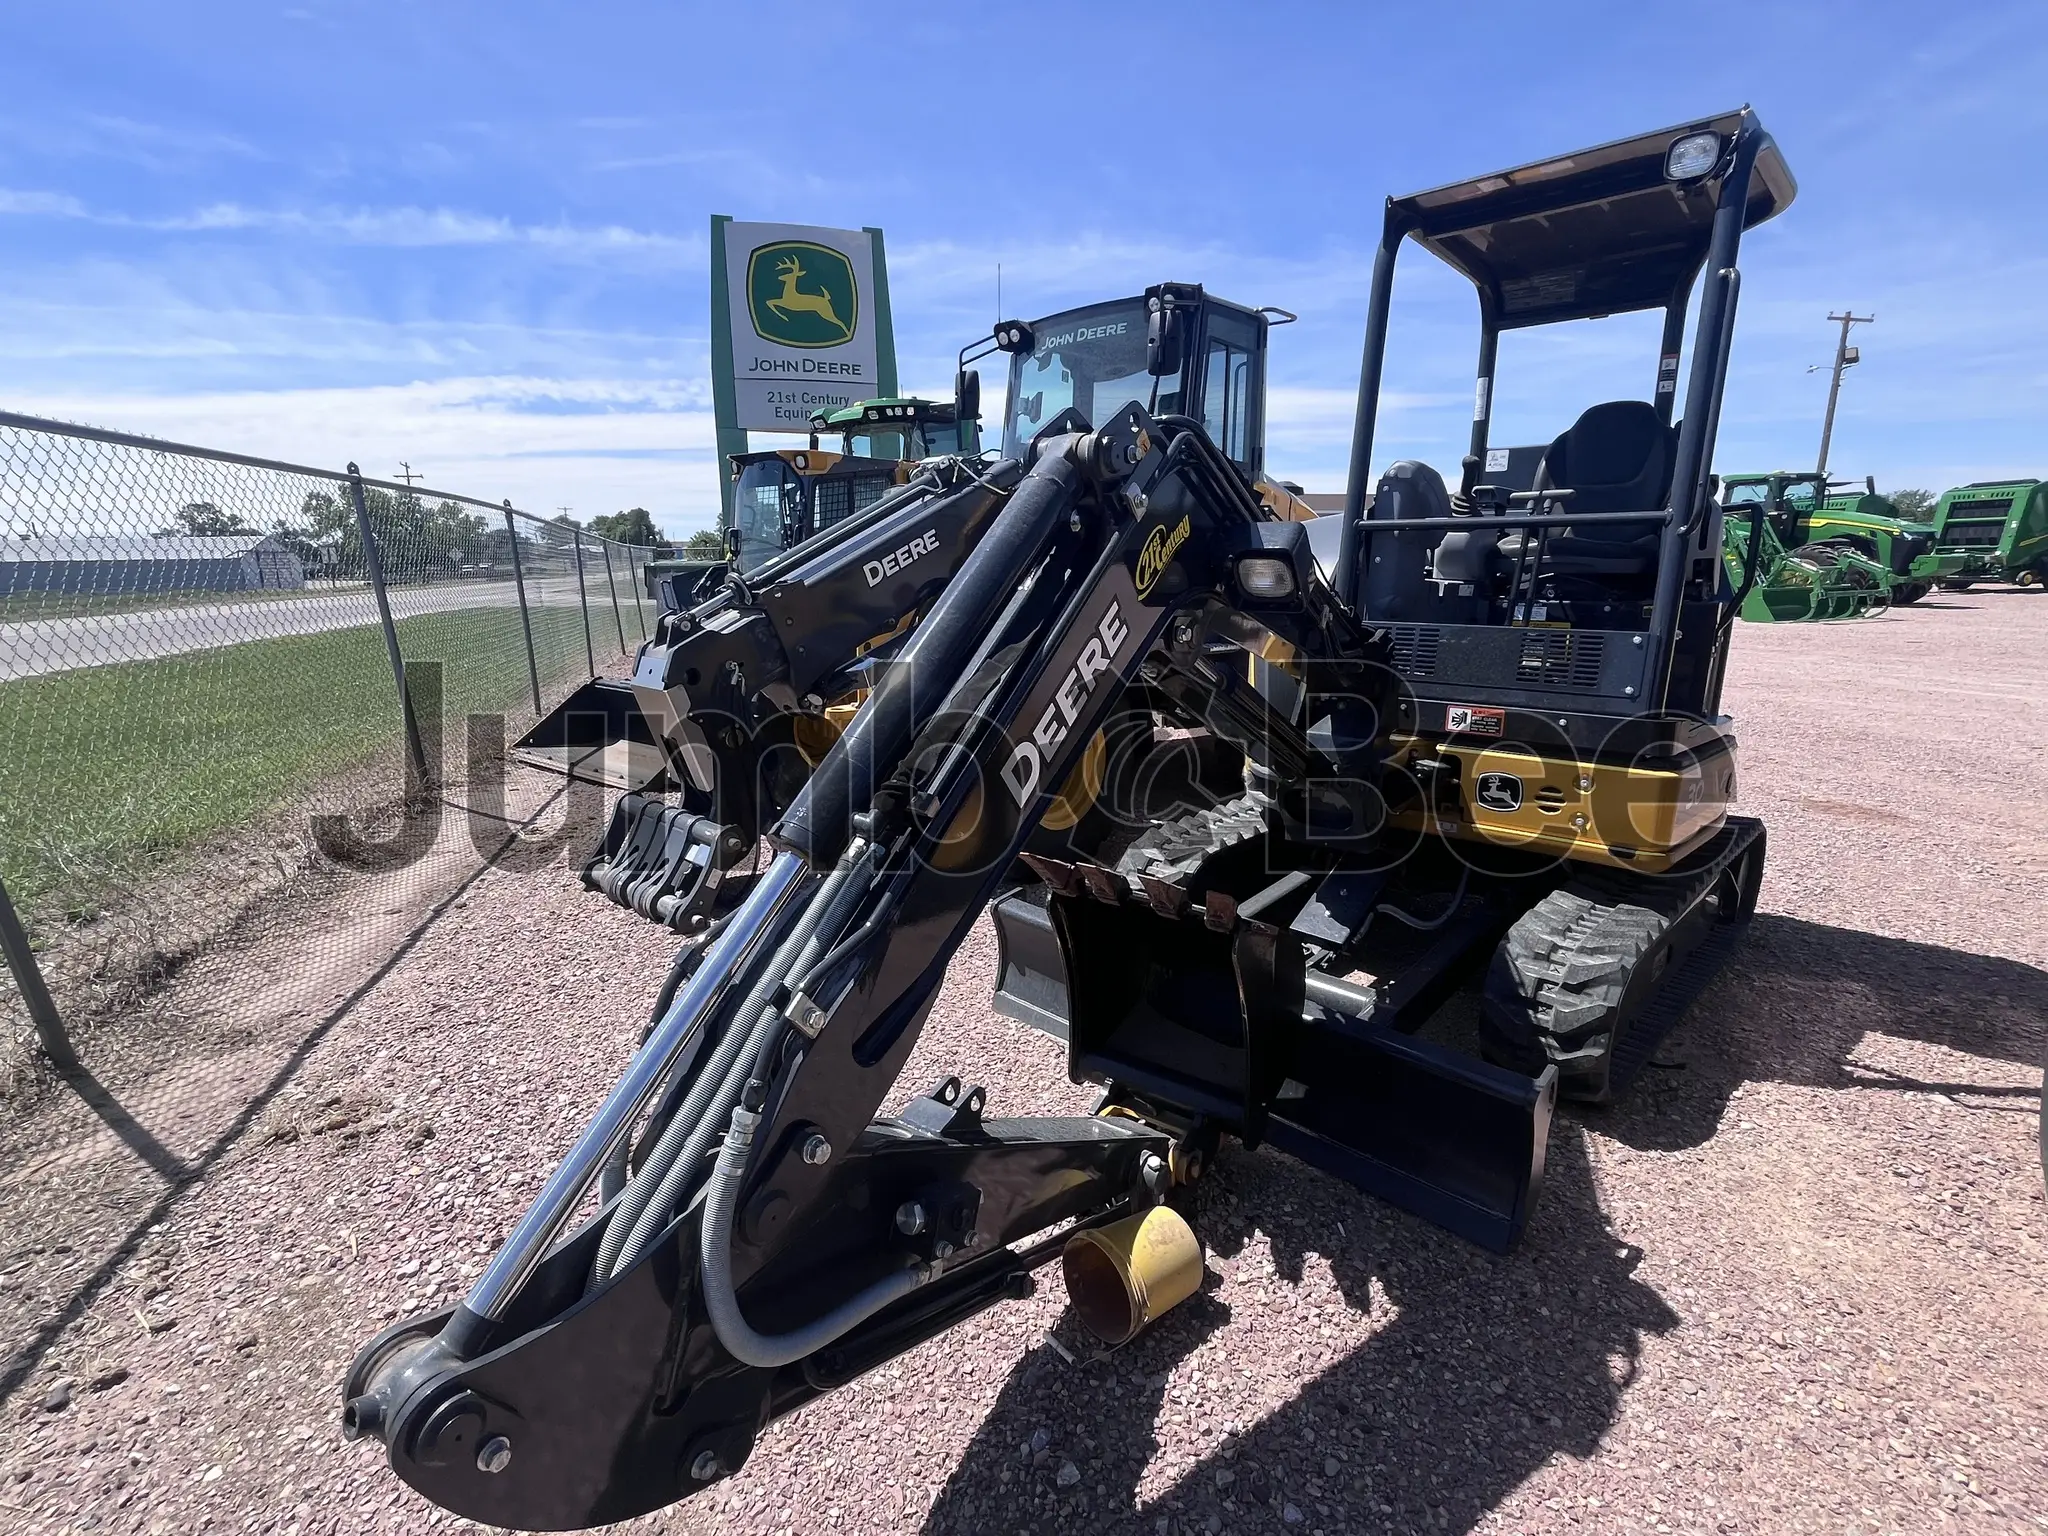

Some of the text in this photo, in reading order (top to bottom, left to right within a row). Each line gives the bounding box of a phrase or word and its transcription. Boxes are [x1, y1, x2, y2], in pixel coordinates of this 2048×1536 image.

[1041, 322, 1128, 351] JOHN DEERE
[748, 357, 862, 376] JOHN DEERE
[767, 391, 850, 408] 21st Century
[774, 406, 813, 421] Equip
[862, 528, 940, 588] DEERE
[999, 600, 1129, 809] DEERE
